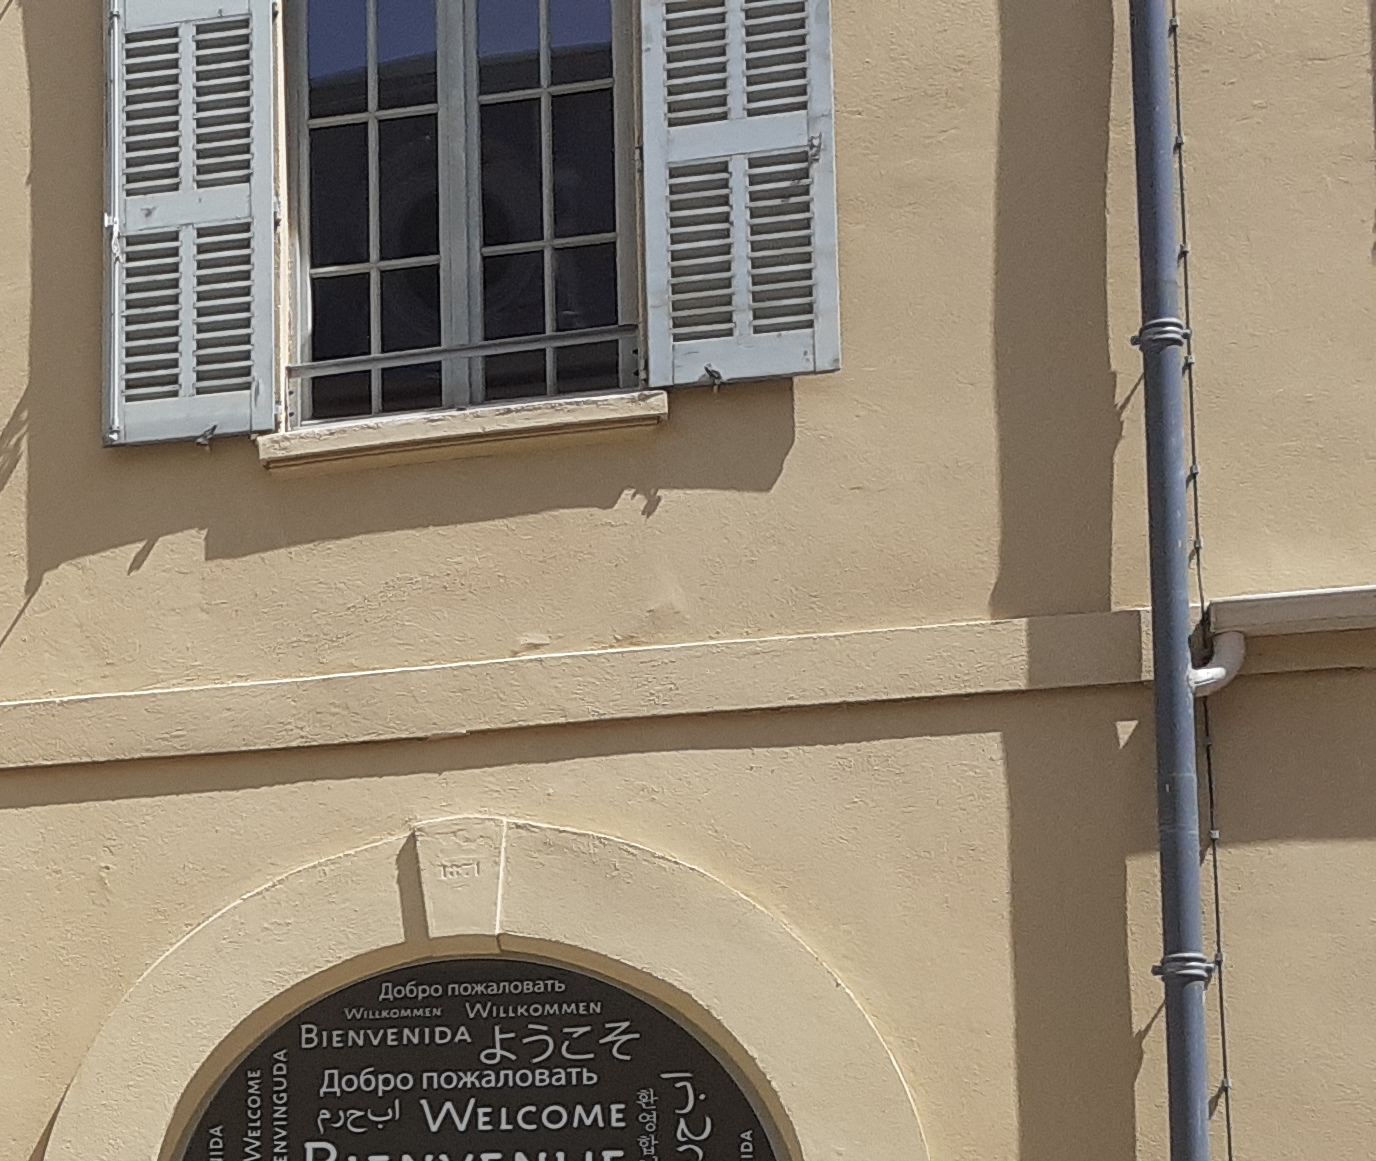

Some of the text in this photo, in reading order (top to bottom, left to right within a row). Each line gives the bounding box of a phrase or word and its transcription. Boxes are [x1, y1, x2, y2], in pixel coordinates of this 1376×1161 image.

[378, 979, 566, 1001] Добро пожаловать
[465, 1001, 602, 1019] WILLKOMMEN
[300, 1024, 472, 1049] BIENVENIDA
[479, 1021, 641, 1064] ようこそ
[319, 1067, 598, 1097] Добро пожаловать
[420, 1098, 626, 1132] WELCOME
